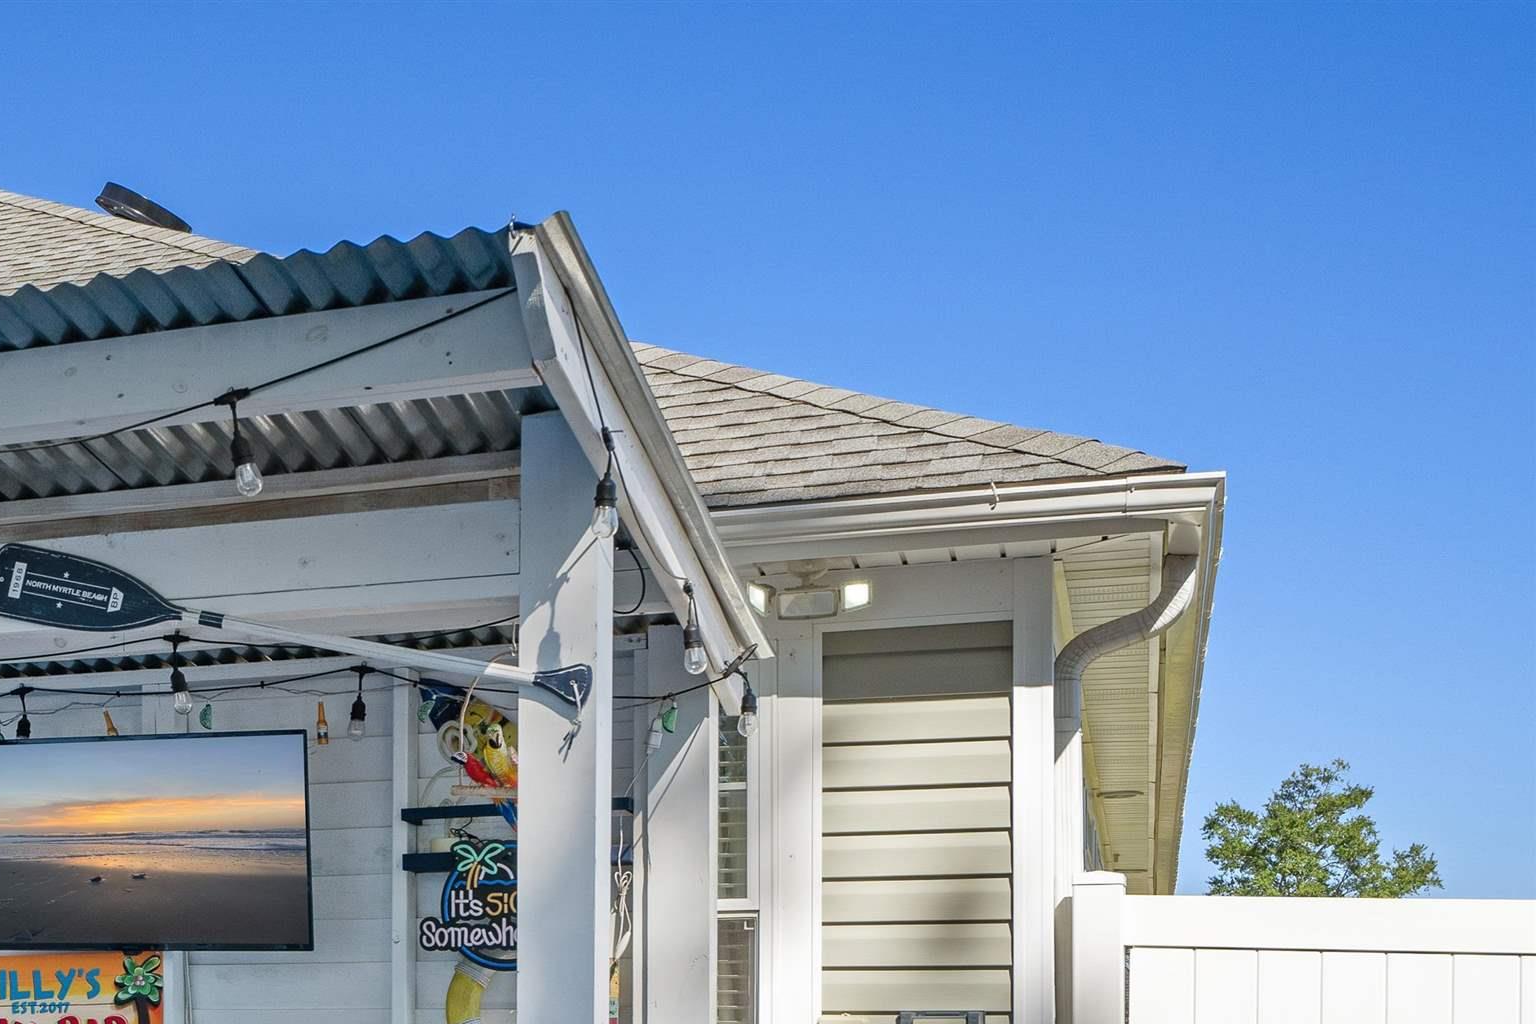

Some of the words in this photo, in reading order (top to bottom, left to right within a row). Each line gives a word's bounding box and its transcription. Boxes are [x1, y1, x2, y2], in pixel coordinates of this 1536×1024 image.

[26, 579, 52, 591] NORTH
[52, 583, 82, 597] MYRTLE
[81, 590, 108, 602] BEACH
[111, 591, 122, 608] BP
[451, 889, 483, 918] It's
[422, 917, 517, 947] Somewh
